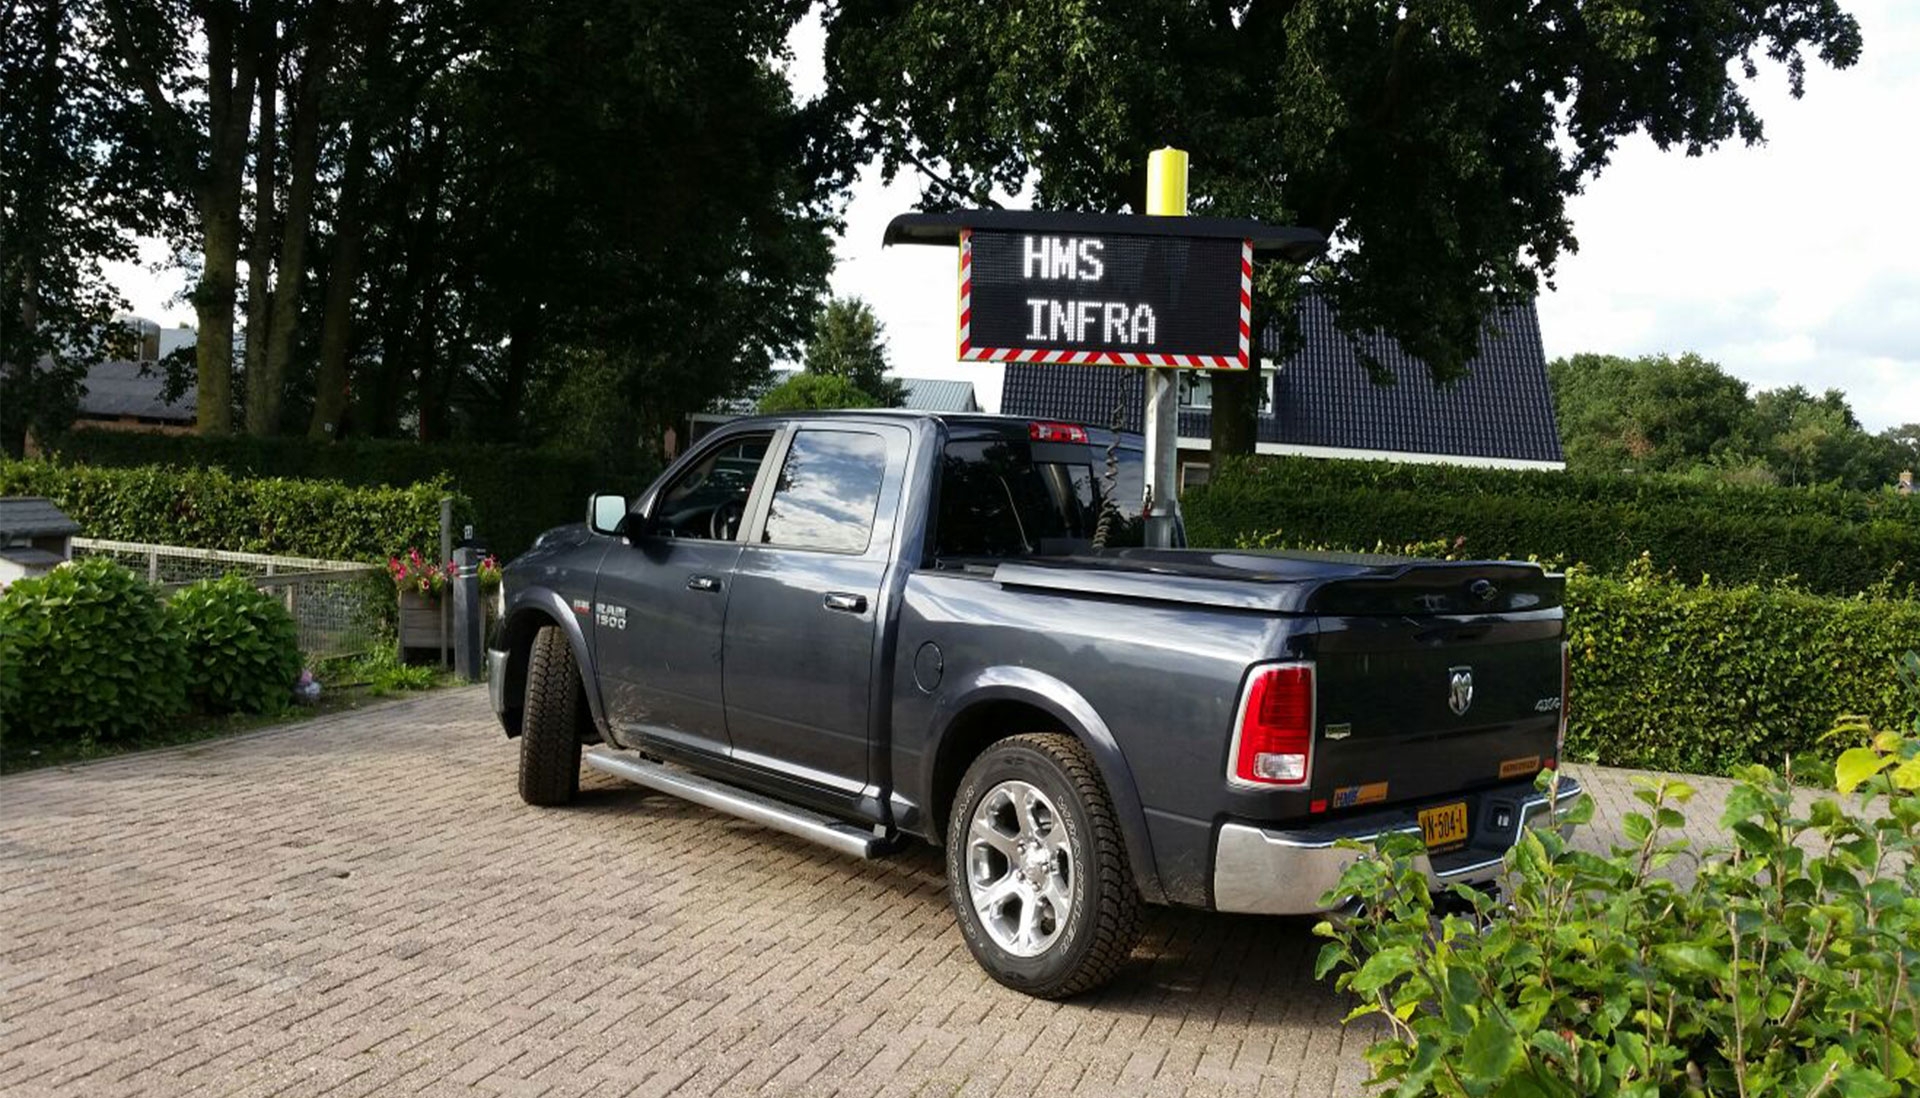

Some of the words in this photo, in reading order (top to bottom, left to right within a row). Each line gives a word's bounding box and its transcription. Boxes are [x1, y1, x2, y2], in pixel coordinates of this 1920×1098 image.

[1023, 235, 1105, 281] HMS
[1026, 298, 1156, 345] INFRA
[595, 602, 627, 618] RAM
[596, 613, 627, 630] 1500
